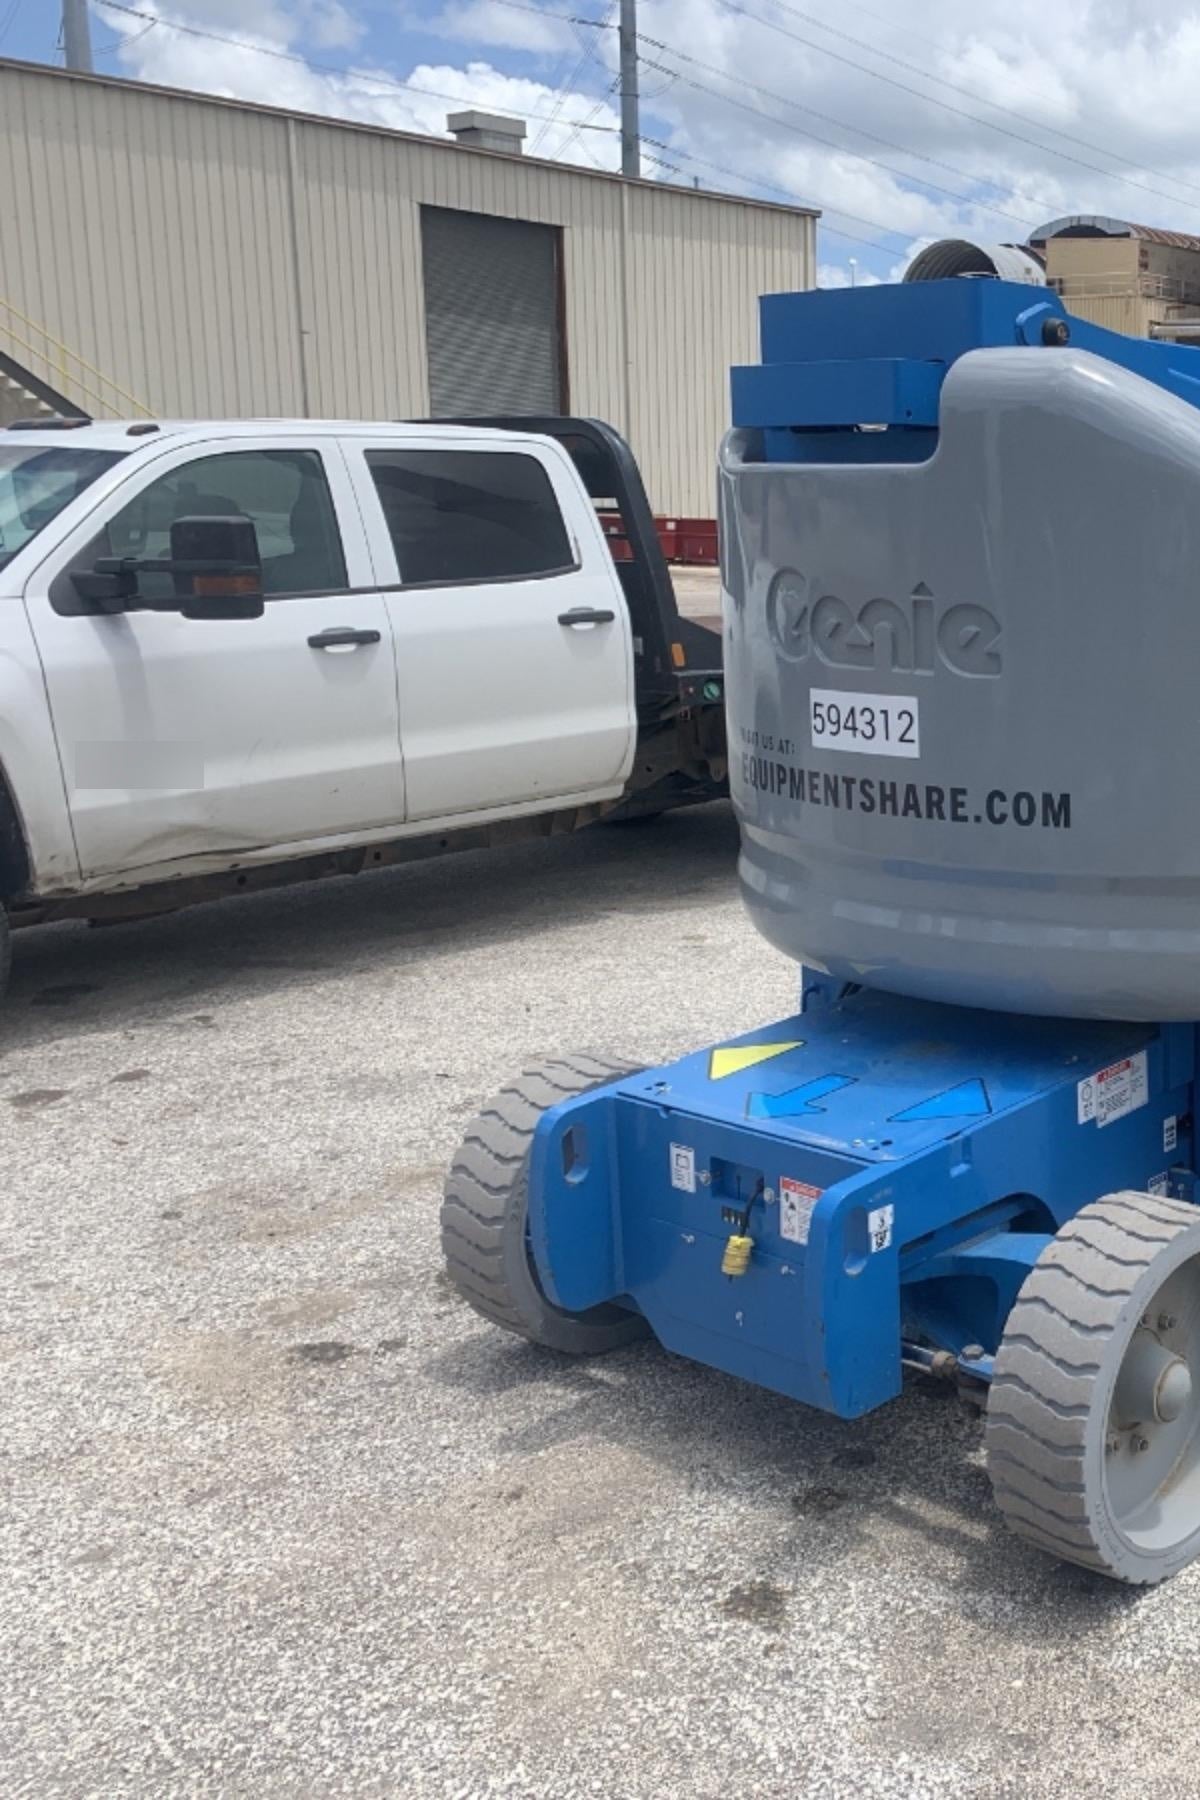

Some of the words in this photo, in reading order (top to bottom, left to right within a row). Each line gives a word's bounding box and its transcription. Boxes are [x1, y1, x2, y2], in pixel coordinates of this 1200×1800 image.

[766, 566, 1003, 679] Genie
[812, 701, 917, 744] 594312
[741, 751, 1072, 829] EQUIPMENTSHARE.COM
